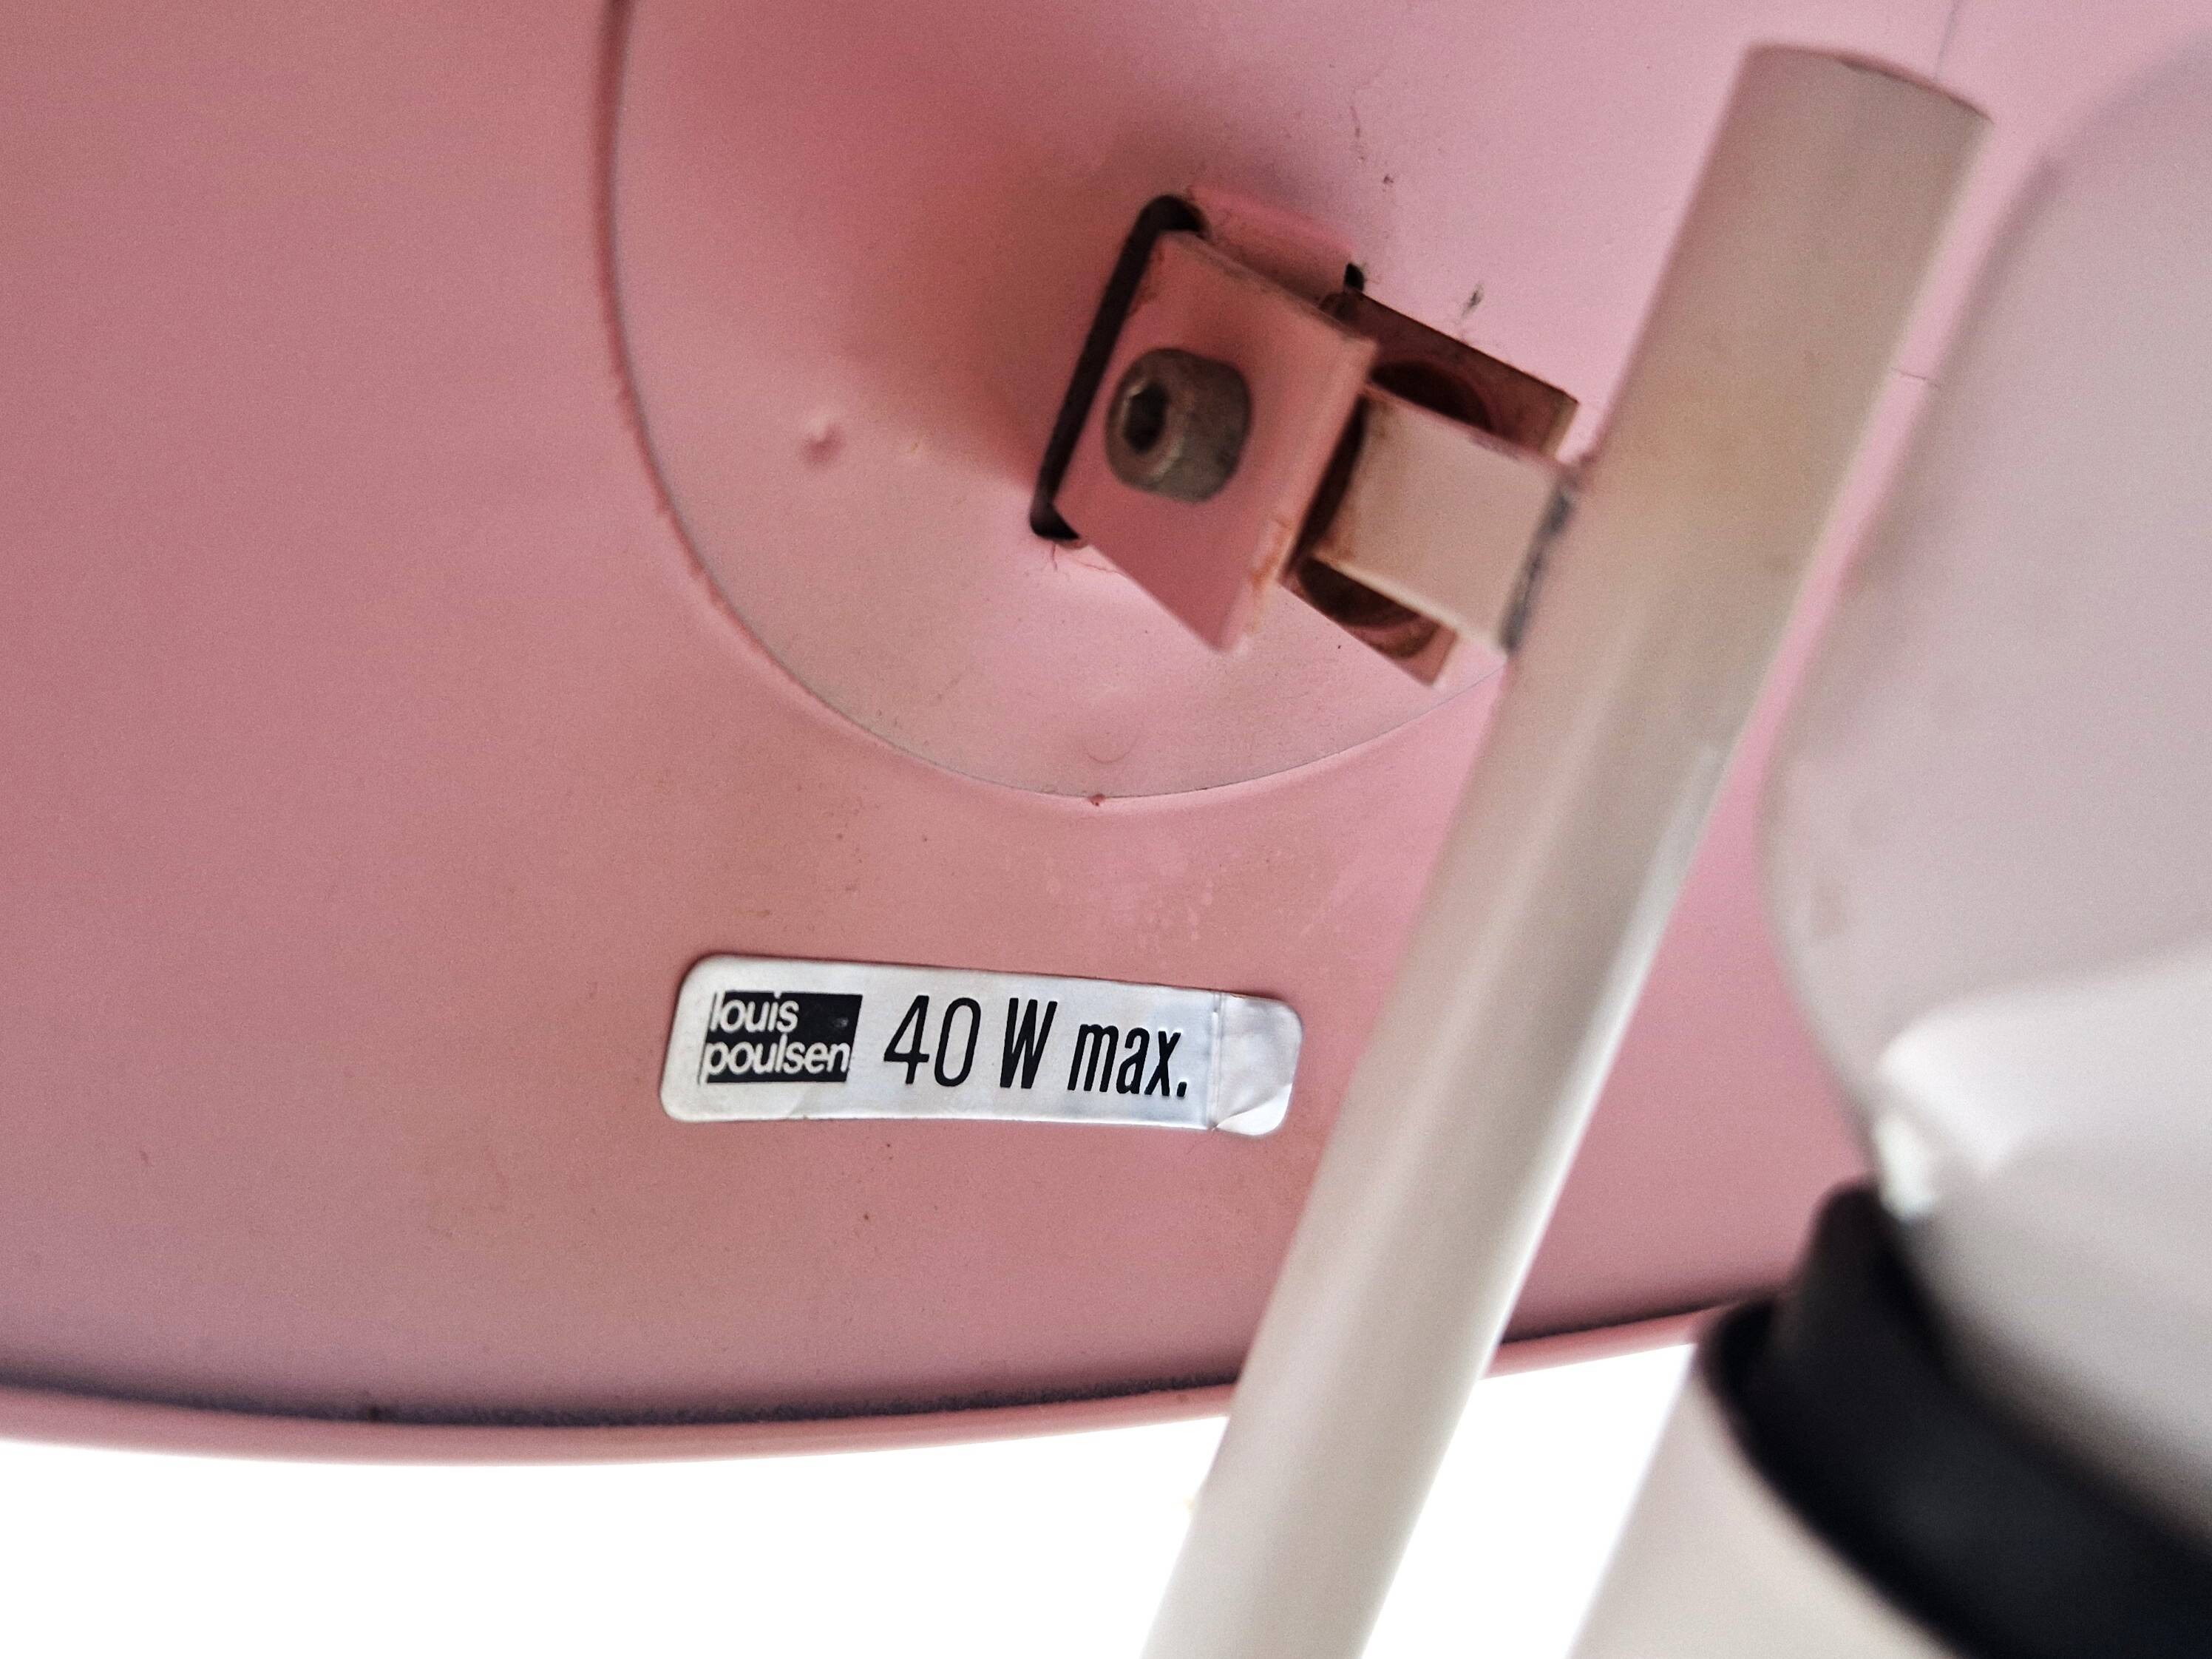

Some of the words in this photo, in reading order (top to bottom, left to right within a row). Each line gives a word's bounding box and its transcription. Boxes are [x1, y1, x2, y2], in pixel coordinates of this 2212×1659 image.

[710, 991, 799, 1034] louis
[704, 1034, 850, 1083] poulsen
[883, 995, 982, 1087] 40
[1000, 997, 1058, 1089] W
[1067, 1024, 1187, 1098] max.
